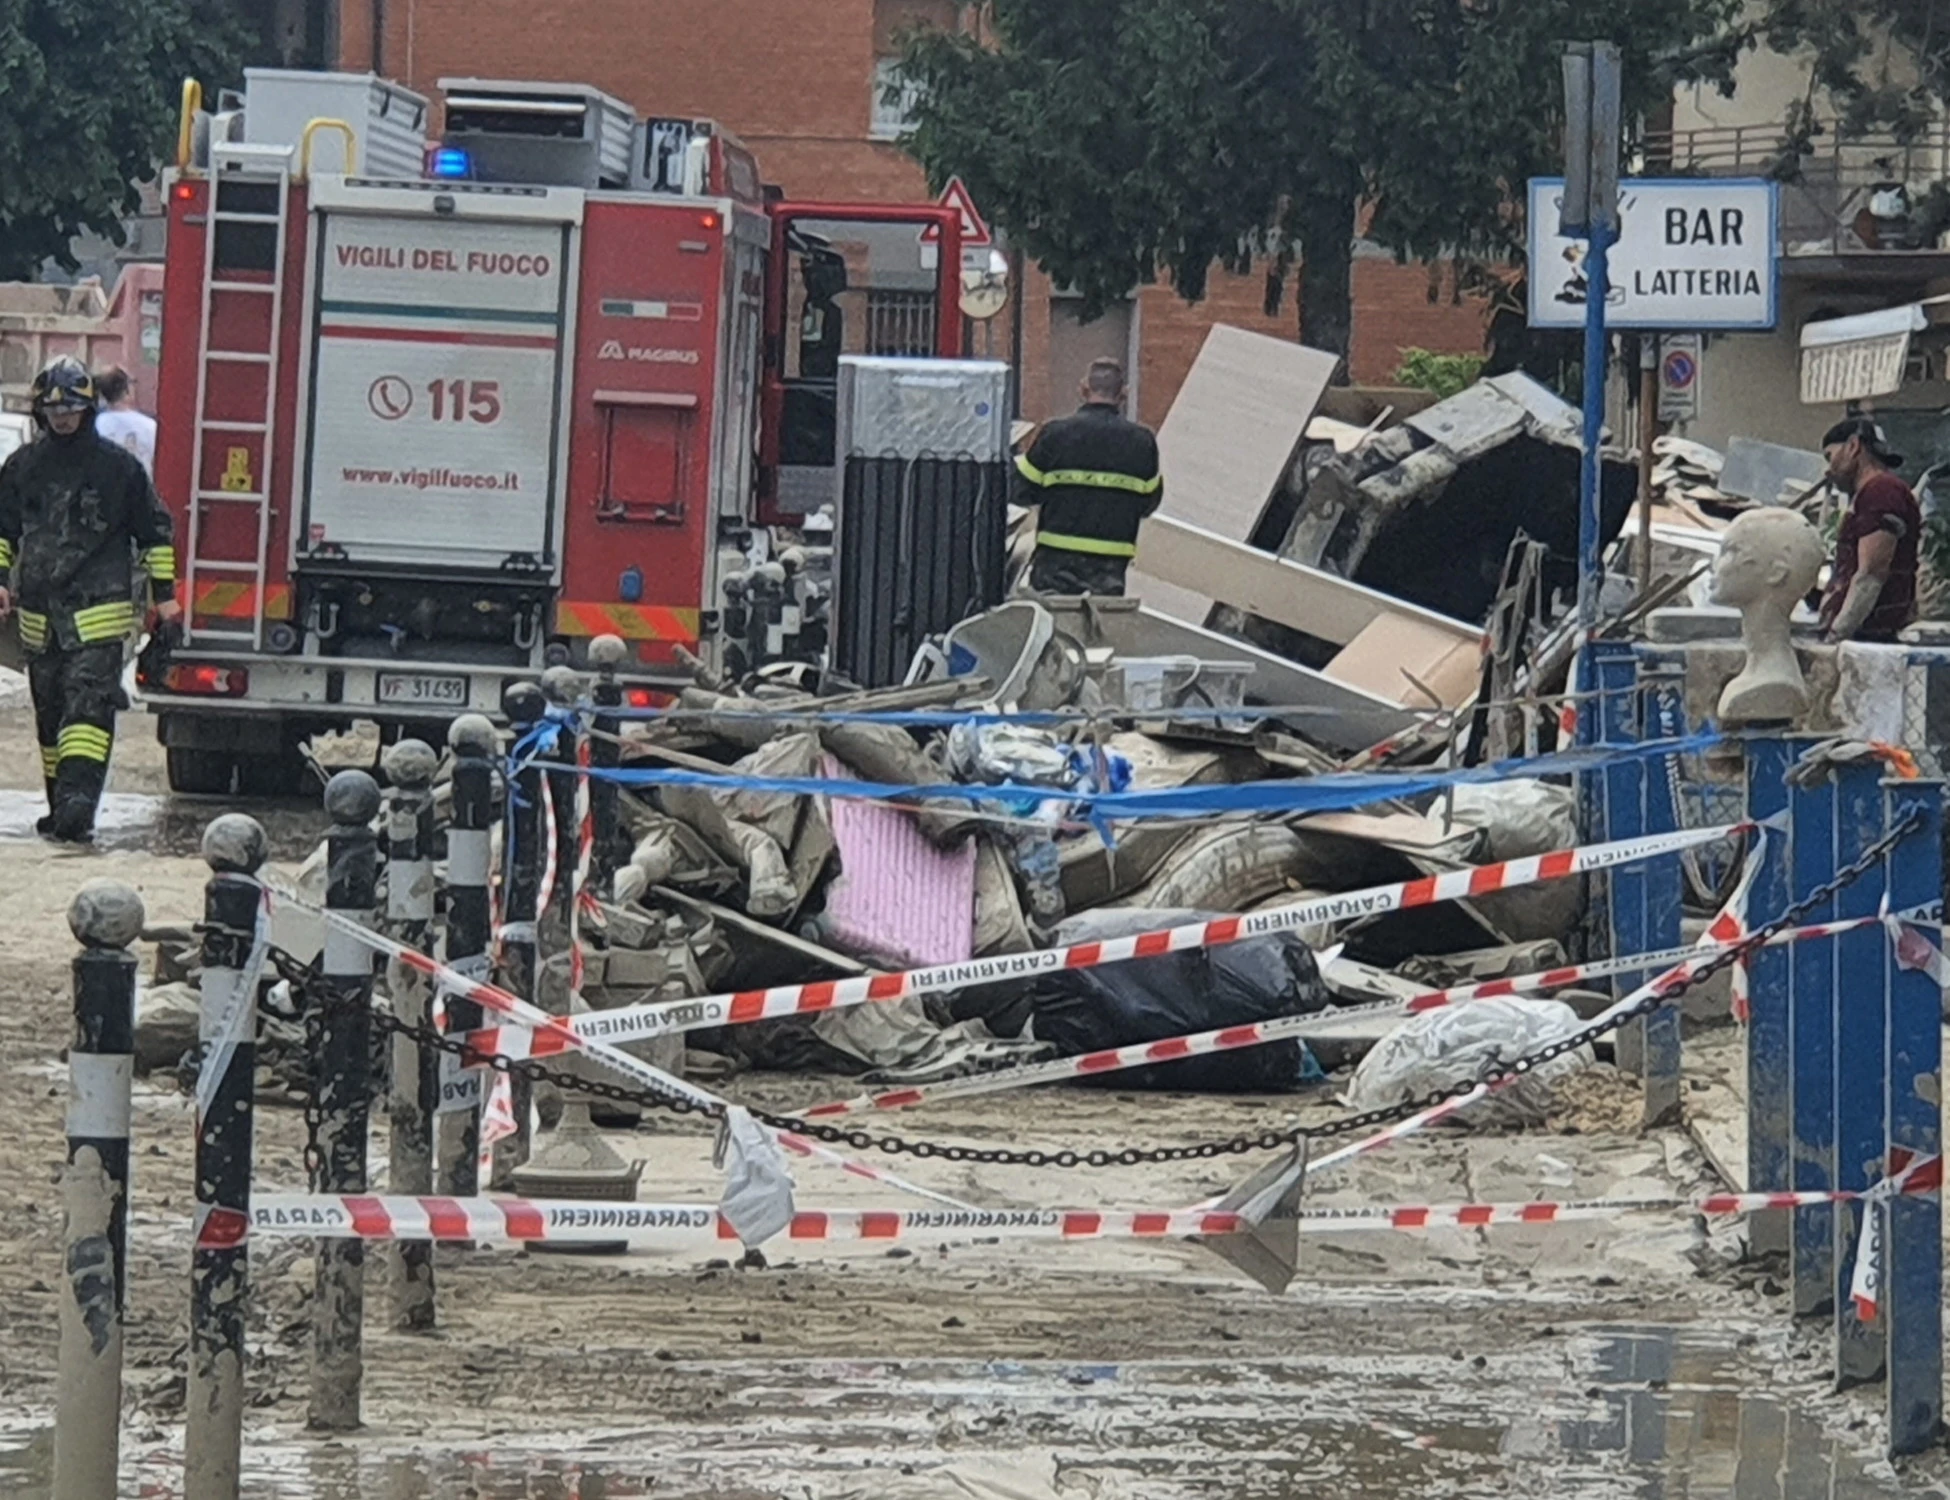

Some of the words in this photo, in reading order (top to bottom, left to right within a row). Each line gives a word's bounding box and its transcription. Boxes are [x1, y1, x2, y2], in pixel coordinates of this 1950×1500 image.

[1664, 207, 1744, 246] BAR
[336, 245, 404, 268] VIGILI
[412, 249, 458, 271] DEL
[467, 252, 550, 276] FUOCO
[1634, 269, 1761, 296] LATTERIA
[427, 378, 501, 423] 115
[342, 467, 519, 490] www.vigilfuoco.it
[910, 952, 1058, 989] CARABINIERI
